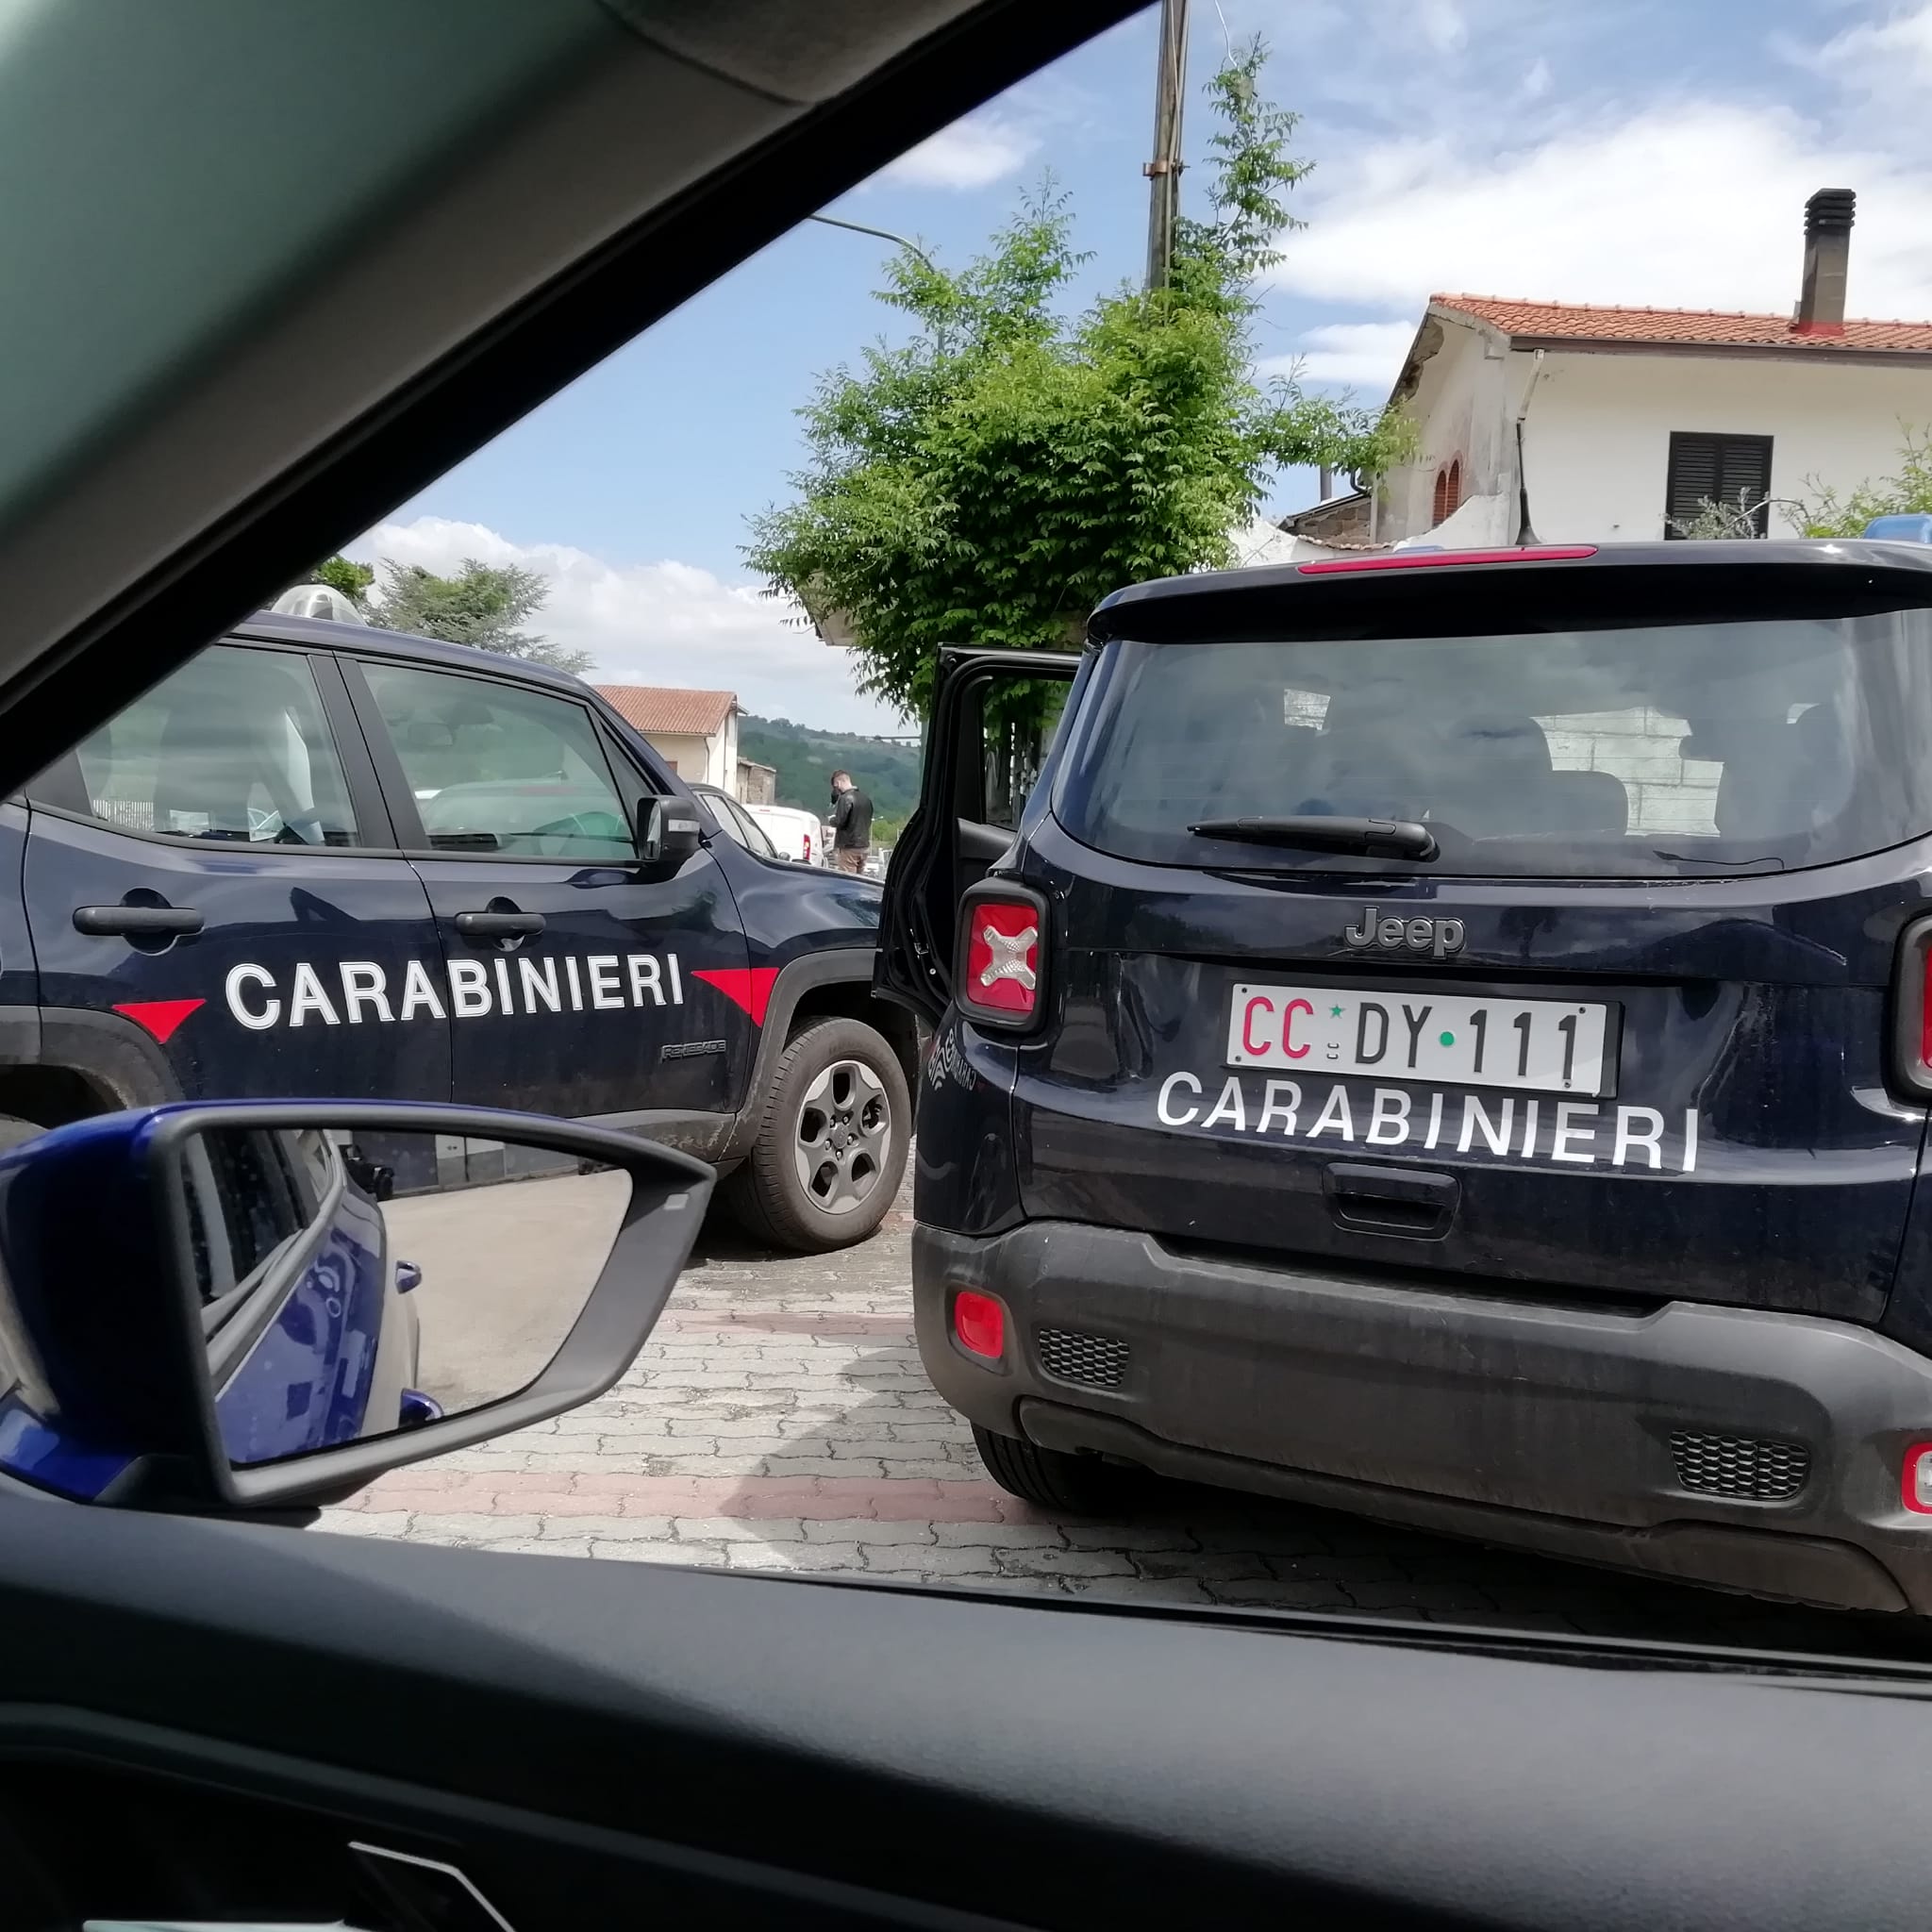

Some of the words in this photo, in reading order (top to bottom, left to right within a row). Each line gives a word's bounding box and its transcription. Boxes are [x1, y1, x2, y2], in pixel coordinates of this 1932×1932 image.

[1344, 906, 1466, 959] Jeep
[225, 953, 684, 1030] CARABINIERI
[1241, 995, 1315, 1058] CC
[1355, 1002, 1432, 1069] DY
[1469, 1008, 1577, 1080] 111
[1157, 1071, 1699, 1173] CARABINIERI
